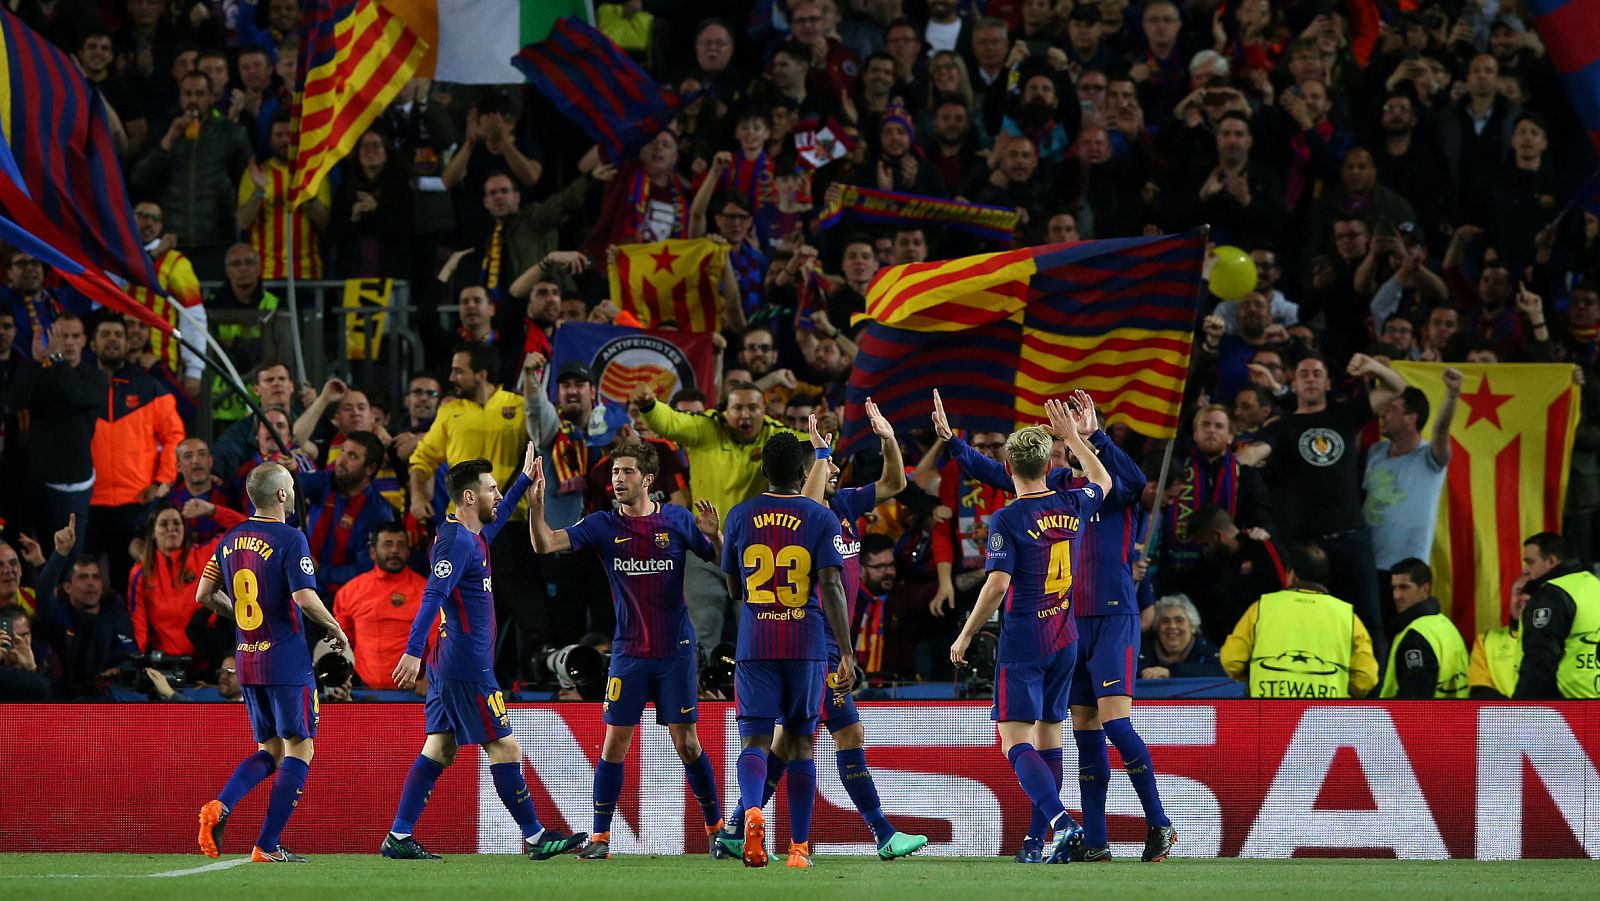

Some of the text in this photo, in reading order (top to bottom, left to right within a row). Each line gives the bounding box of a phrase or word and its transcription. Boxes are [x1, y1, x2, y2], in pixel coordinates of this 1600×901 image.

[752, 512, 802, 531] UMTITI
[222, 536, 274, 561] A. INIESTA
[613, 558, 674, 571] Rakuten
[743, 543, 812, 608] 23
[1044, 539, 1072, 599] 4
[233, 568, 264, 631] 8
[757, 608, 791, 620] unicef
[1259, 680, 1338, 698] STEWARD
[487, 690, 508, 718] 10
[477, 705, 1600, 860] NISSAN
